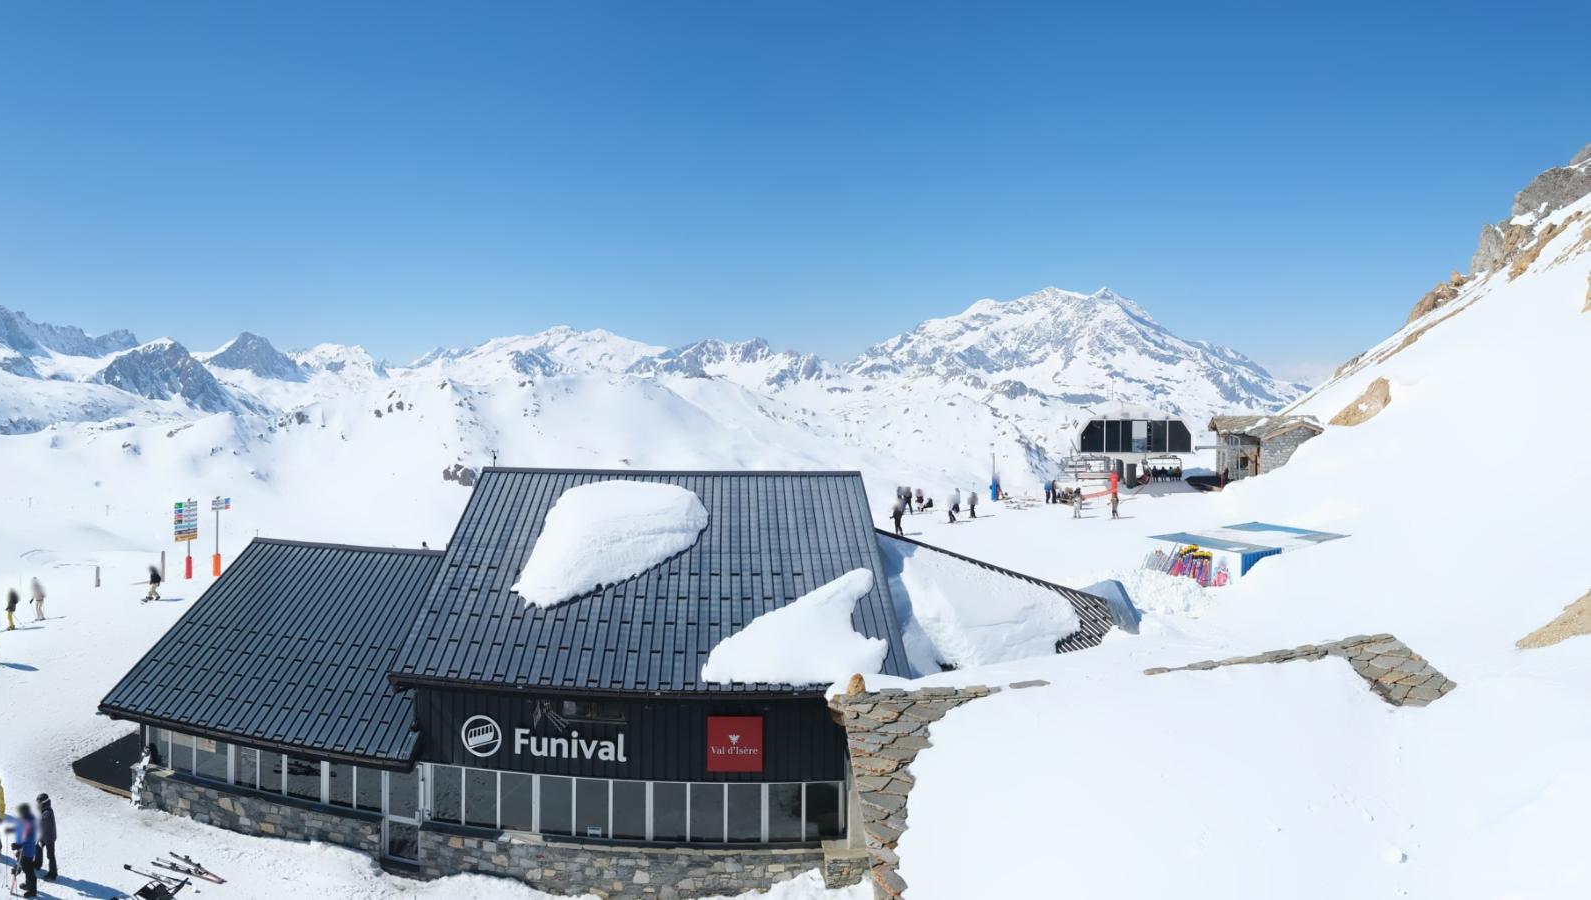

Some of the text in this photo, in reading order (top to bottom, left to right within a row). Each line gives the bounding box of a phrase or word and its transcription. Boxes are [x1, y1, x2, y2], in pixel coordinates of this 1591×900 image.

[514, 728, 627, 762] Funival
[711, 745, 758, 755] Val d'Isère
